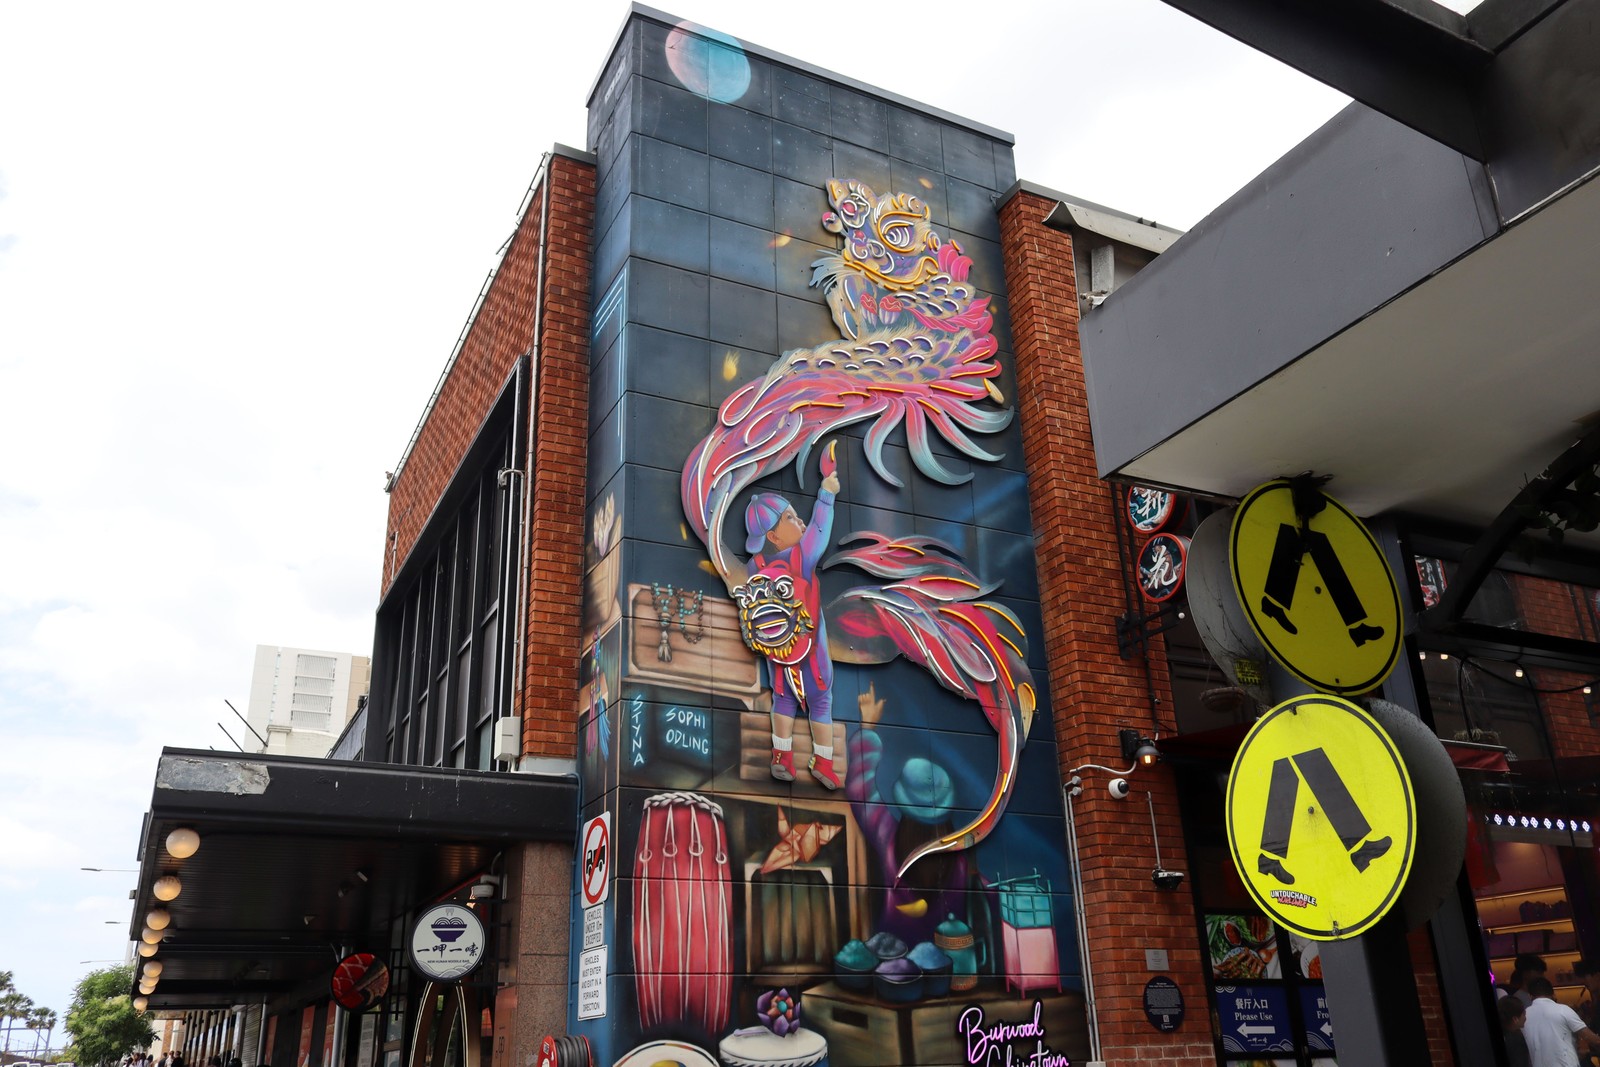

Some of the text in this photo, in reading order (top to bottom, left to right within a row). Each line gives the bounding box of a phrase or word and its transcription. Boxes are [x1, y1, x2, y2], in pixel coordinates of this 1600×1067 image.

[665, 707, 706, 729] SOPHI
[631, 694, 645, 767] STYNA
[665, 729, 709, 755] ODLING
[586, 908, 602, 922] VEHICLES
[584, 954, 600, 966] VEHICLES
[582, 965, 602, 977] MUST ENTER
[587, 979, 595, 988] EXIT
[583, 990, 600, 1000] FORWARD
[582, 1001, 600, 1012] DIRECTION
[1235, 998, 1268, 1009] 餐厅入口
[1234, 1012, 1273, 1021] Please Use
[959, 1001, 1044, 1064] Burwood
